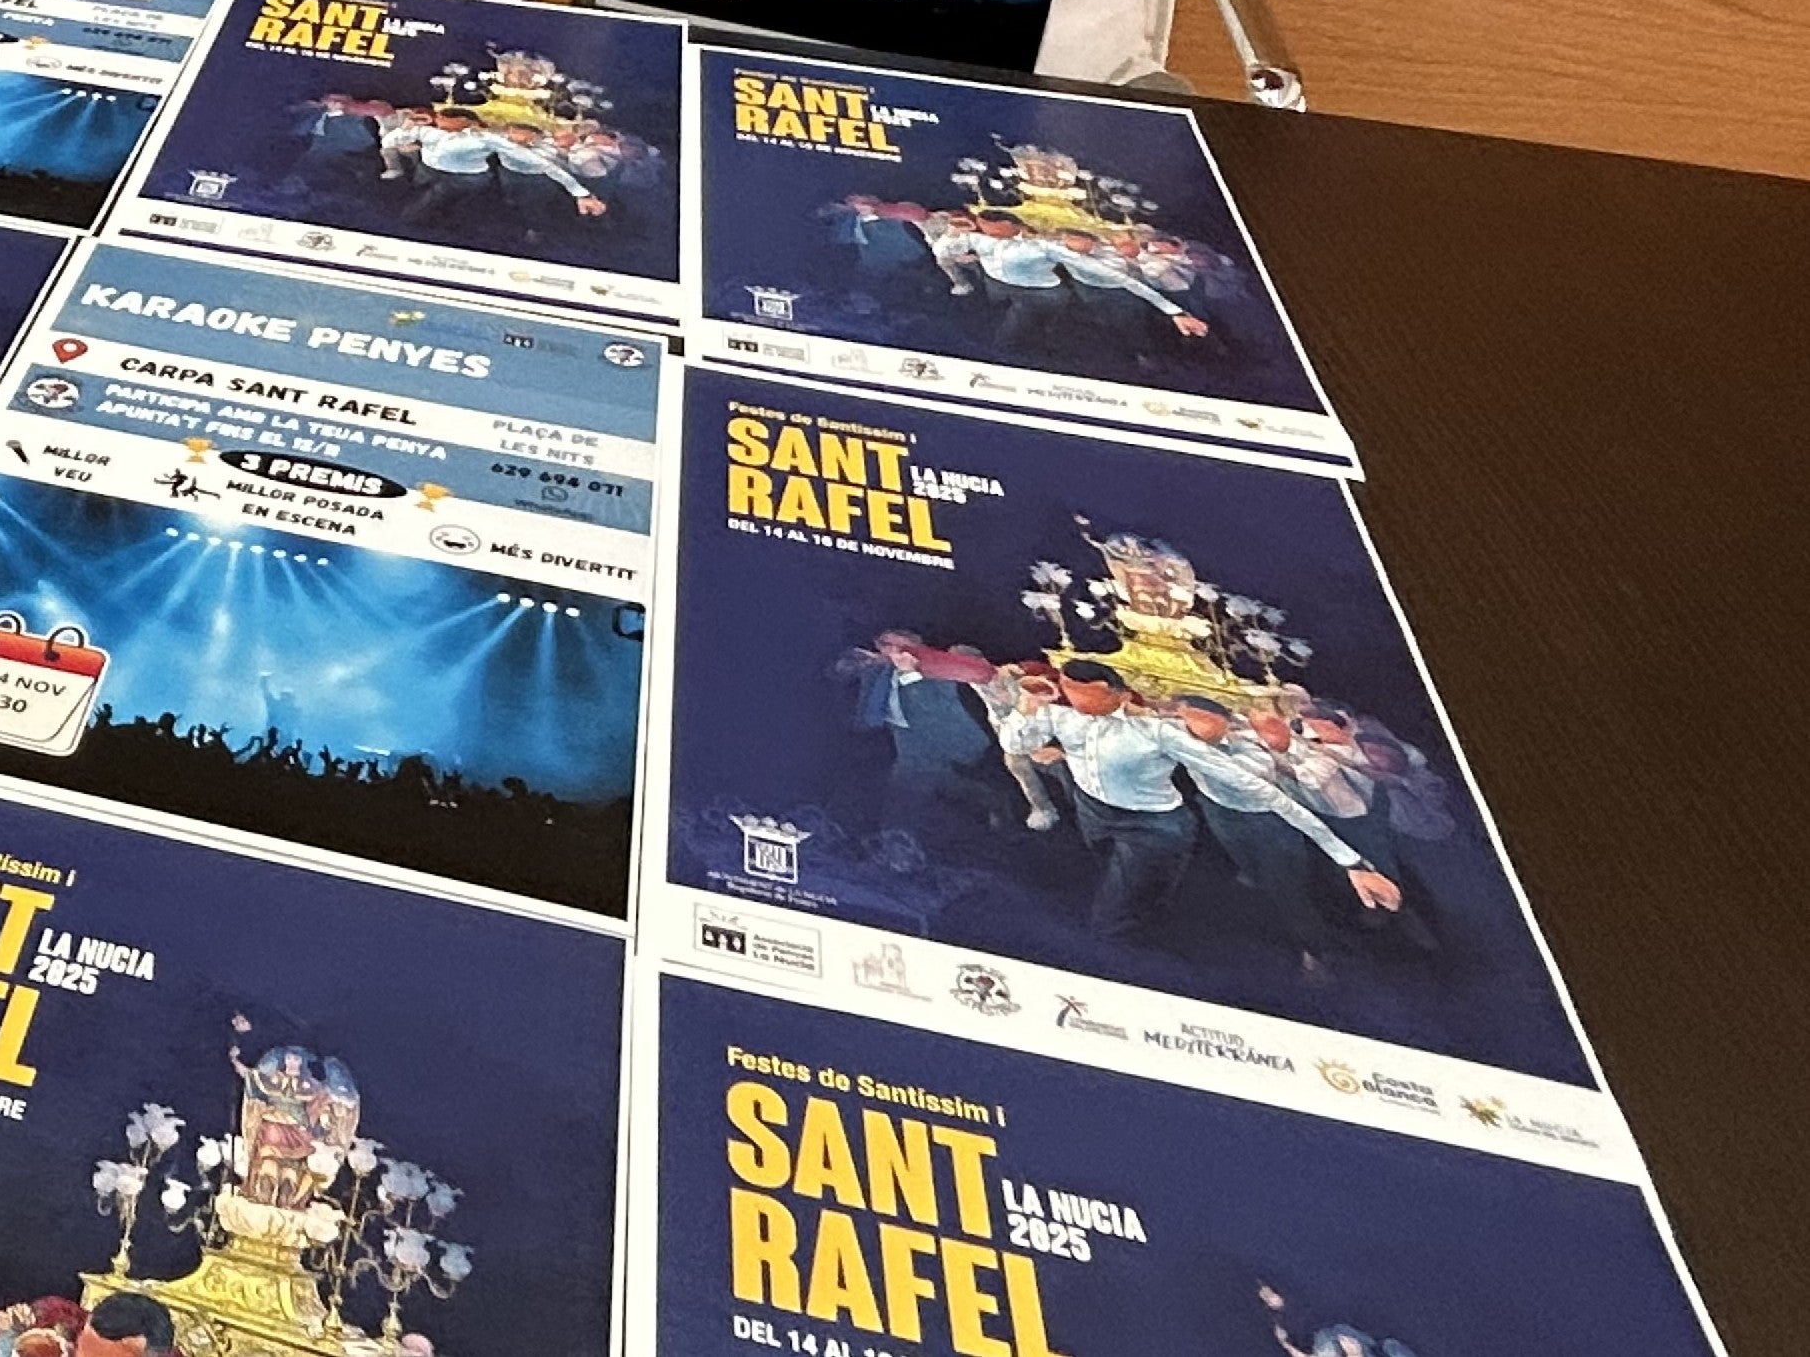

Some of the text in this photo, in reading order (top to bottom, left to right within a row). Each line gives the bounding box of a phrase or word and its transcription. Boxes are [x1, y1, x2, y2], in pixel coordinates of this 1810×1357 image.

[249, 17, 395, 60] RAFEL
[733, 76, 869, 119] SANT
[735, 103, 901, 155] RAFEL
[81, 284, 493, 379] KARAOKE PENYES
[119, 356, 417, 426] CARPA SANT RAFEL
[492, 418, 600, 448] PLAÇA DE
[498, 439, 594, 467] LES NITS
[727, 417, 908, 492] SANT
[42, 443, 111, 468] MILLOR
[53, 466, 92, 484] VEU
[240, 453, 384, 497] 3 PREMIS
[910, 465, 937, 485] LA
[225, 480, 384, 521] MILLOR POSADA
[491, 461, 624, 498] 629 694 071
[241, 504, 357, 537] EN ESCENA
[728, 463, 951, 552] RAFEL
[490, 540, 637, 583] MÉS DIVERTIT
[728, 519, 955, 569] DEL 14 AL 16 DE NOVEMBRE
[15, 675, 67, 698] NOV
[28, 955, 99, 995] 2025
[37, 927, 157, 981] LA NUCIA
[726, 1046, 810, 1083] Festes
[819, 1068, 851, 1092] de
[725, 1081, 997, 1240] SANT
[1000, 1179, 1147, 1243] LA NUCIA
[1009, 1213, 1092, 1263] 2025
[730, 1187, 1073, 1357] RAFEL
[732, 1315, 784, 1349] DEL
